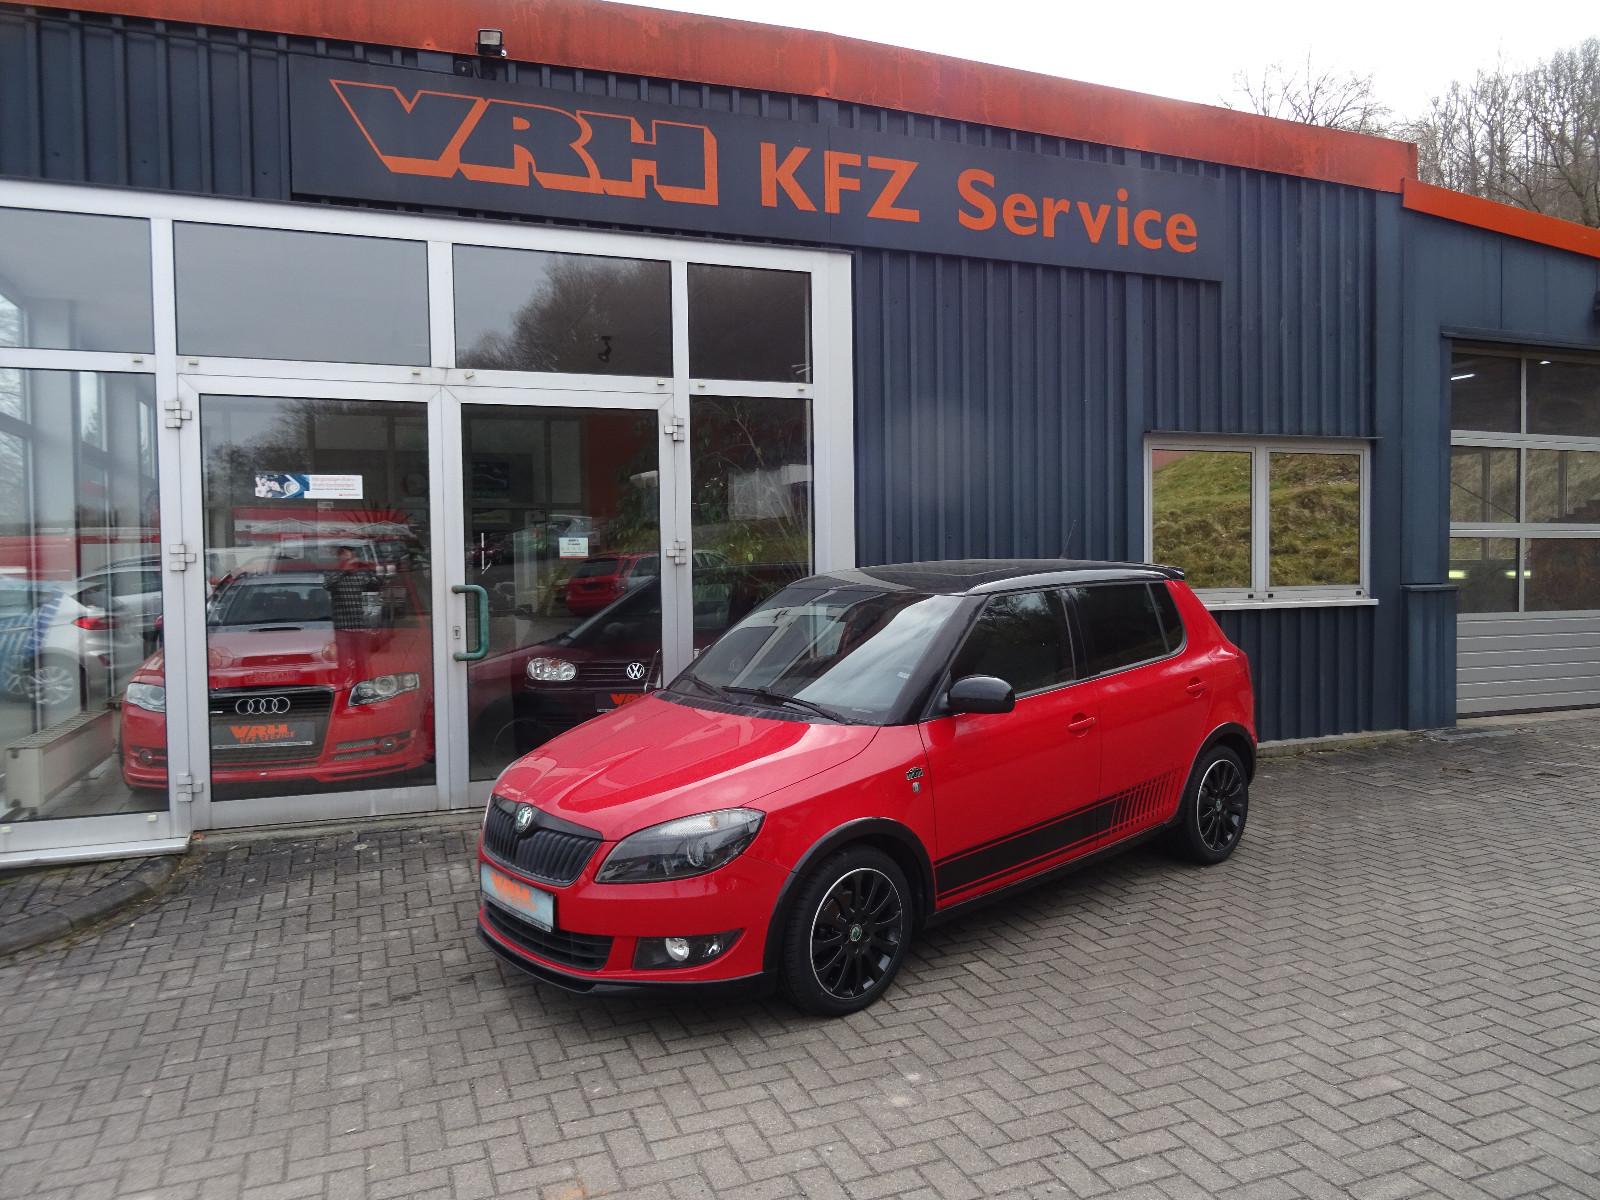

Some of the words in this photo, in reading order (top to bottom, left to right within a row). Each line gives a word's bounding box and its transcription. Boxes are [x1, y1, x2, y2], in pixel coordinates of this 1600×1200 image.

[330, 79, 718, 206] VRH
[760, 142, 920, 223] KFZ
[957, 168, 1197, 254] Service
